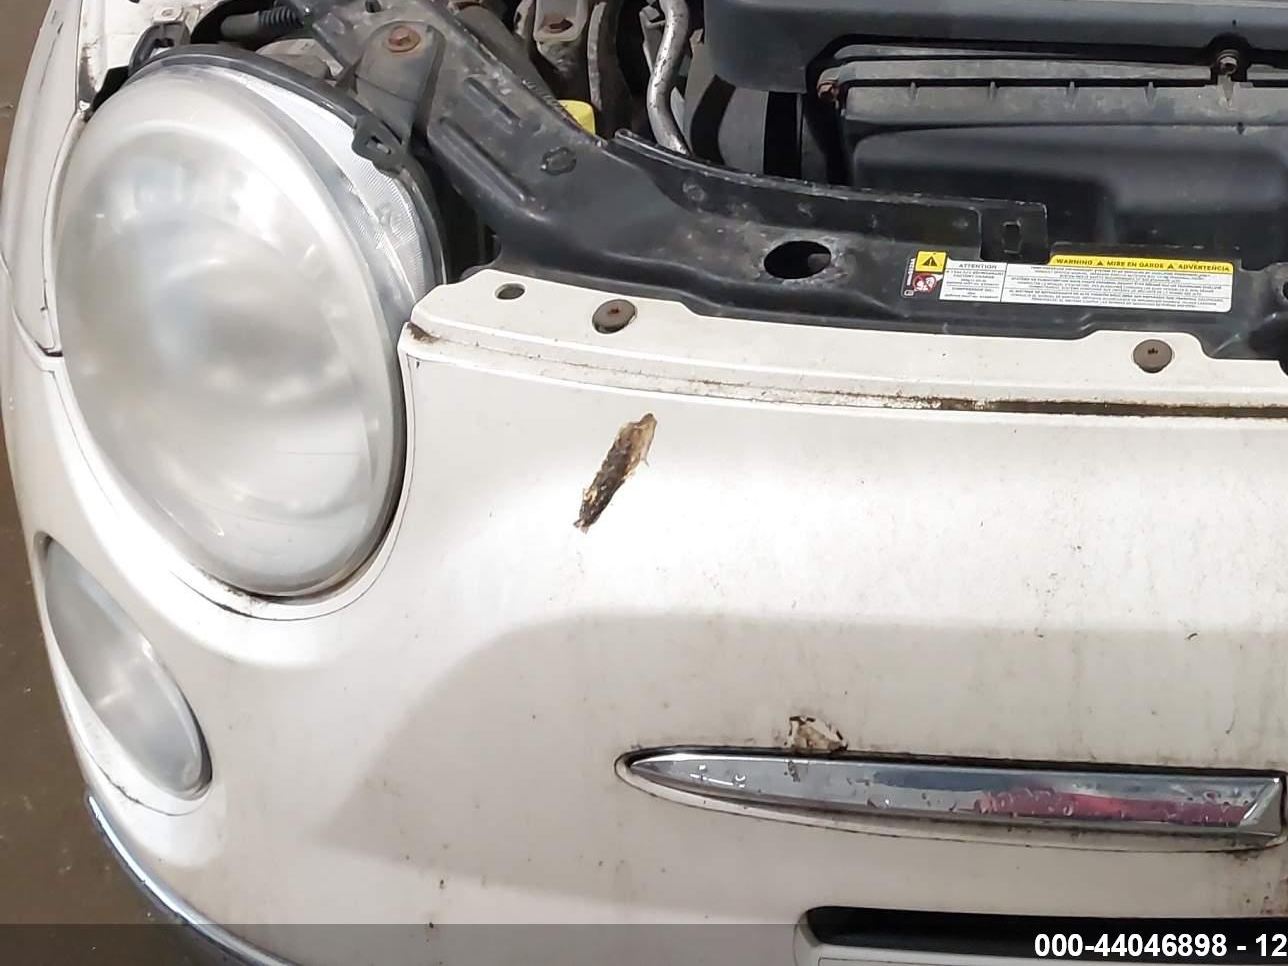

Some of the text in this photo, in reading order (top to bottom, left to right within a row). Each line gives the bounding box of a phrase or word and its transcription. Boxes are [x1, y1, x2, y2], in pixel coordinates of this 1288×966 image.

[958, 263, 997, 271] ATTENTION
[1055, 258, 1093, 266] WARNING
[1139, 262, 1165, 270] GARDE
[1177, 263, 1230, 272] ADVERTENCIA
